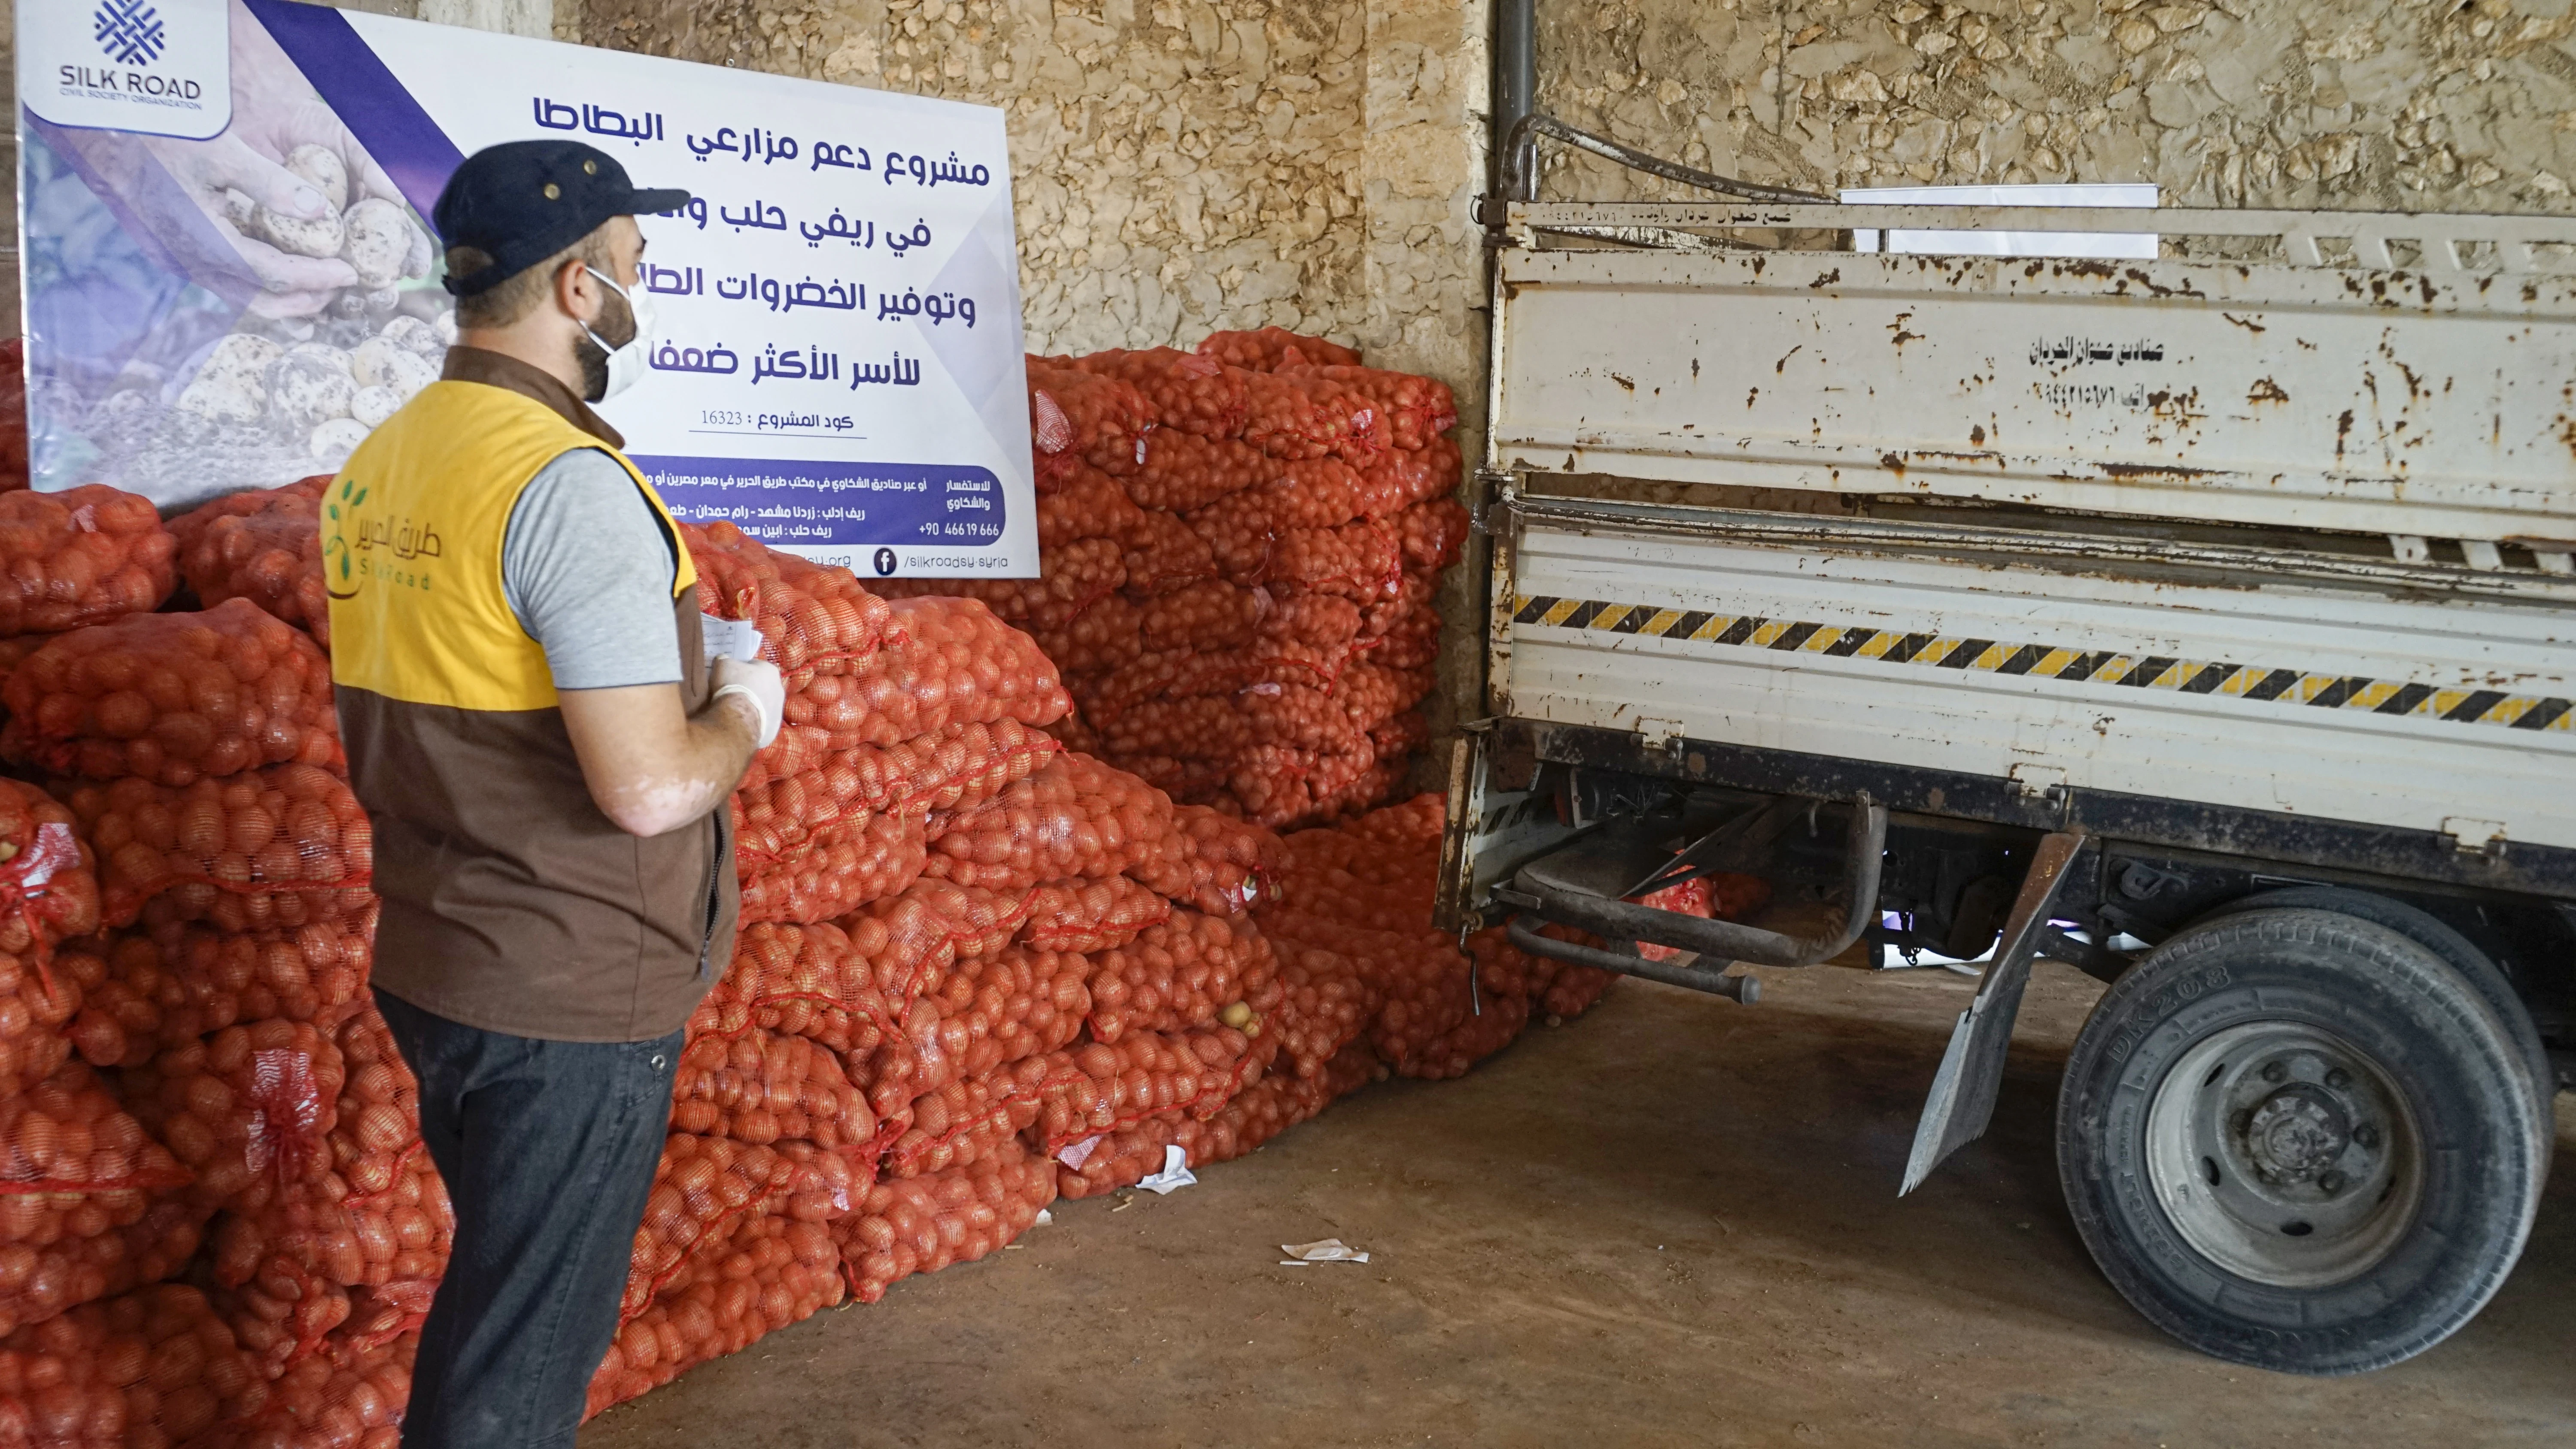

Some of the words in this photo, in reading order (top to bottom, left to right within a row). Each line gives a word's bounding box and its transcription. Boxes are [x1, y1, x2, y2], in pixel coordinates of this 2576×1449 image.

[60, 65, 118, 90] SILK
[127, 72, 200, 99] ROAD
[59, 87, 85, 97] CIVIL
[88, 90, 128, 101] SOCIETY
[131, 94, 202, 111] ORGANIZATION
[533, 97, 663, 147] البطاطا
[687, 127, 799, 166] مزارعي
[811, 141, 872, 172] دعم
[884, 151, 990, 188] مشروع
[720, 200, 787, 233] حلب
[800, 206, 874, 249] ريفي
[886, 217, 931, 258] في
[717, 273, 866, 313] الخضروات
[877, 286, 976, 329] وتوفير
[751, 343, 838, 386] الأكثر
[850, 350, 920, 391] للأسر
[702, 410, 742, 425] 16323
[757, 410, 820, 430] المشروع
[824, 415, 854, 432] كود
[655, 469, 665, 486] أو
[666, 473, 699, 487] مصرين
[700, 476, 719, 487] معر
[720, 474, 735, 490] في
[736, 475, 761, 488] الحرير
[762, 476, 787, 489] طريق
[788, 476, 815, 490] مكتب
[817, 477, 830, 492] في
[832, 476, 870, 493] الشكاوي
[871, 478, 902, 491] صناديق
[918, 477, 927, 492] أو
[903, 482, 917, 492] عبر
[946, 479, 990, 493] للاستفسار
[757, 504, 791, 518] مشهد
[947, 495, 990, 512] والشكاوي
[696, 504, 729, 519] حمدان
[732, 505, 749, 520] رام
[793, 506, 815, 520] زردنا
[822, 506, 844, 521] إدلب
[845, 507, 865, 521] ريف
[762, 524, 783, 538] ابين
[789, 524, 810, 538] حلب
[811, 524, 832, 538] ريف
[919, 522, 939, 535] +90
[945, 523, 965, 535] 466
[966, 523, 977, 535] 19
[980, 523, 999, 536] 666
